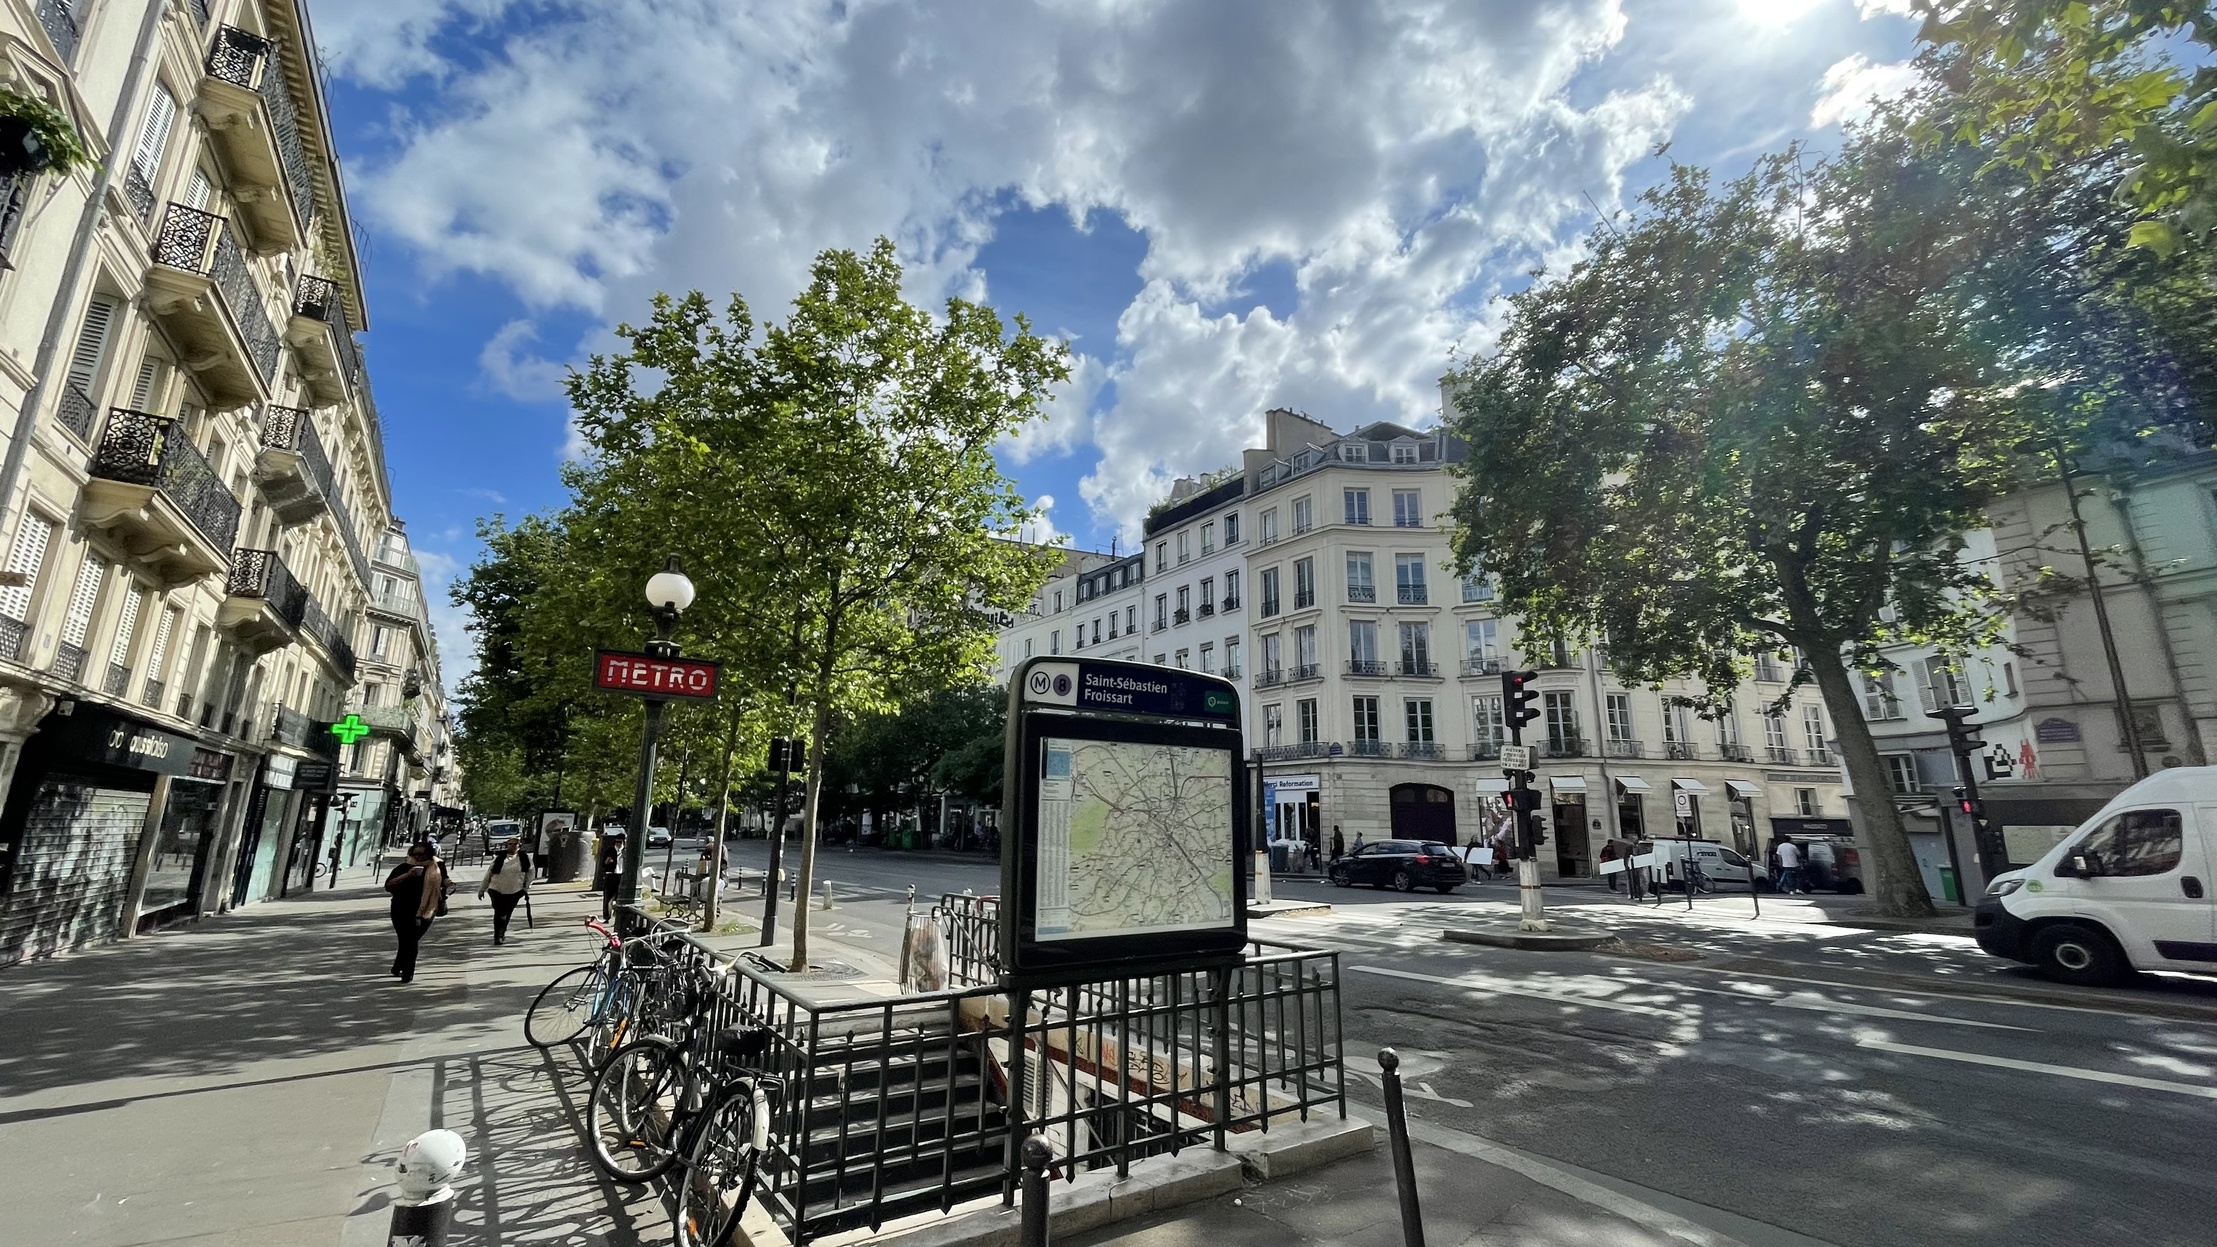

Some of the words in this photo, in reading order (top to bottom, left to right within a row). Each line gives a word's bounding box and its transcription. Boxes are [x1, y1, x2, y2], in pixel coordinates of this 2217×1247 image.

[607, 659, 708, 691] METRO
[1084, 673, 1168, 694] Saint-Sébastien
[1083, 688, 1134, 705] Froissart
